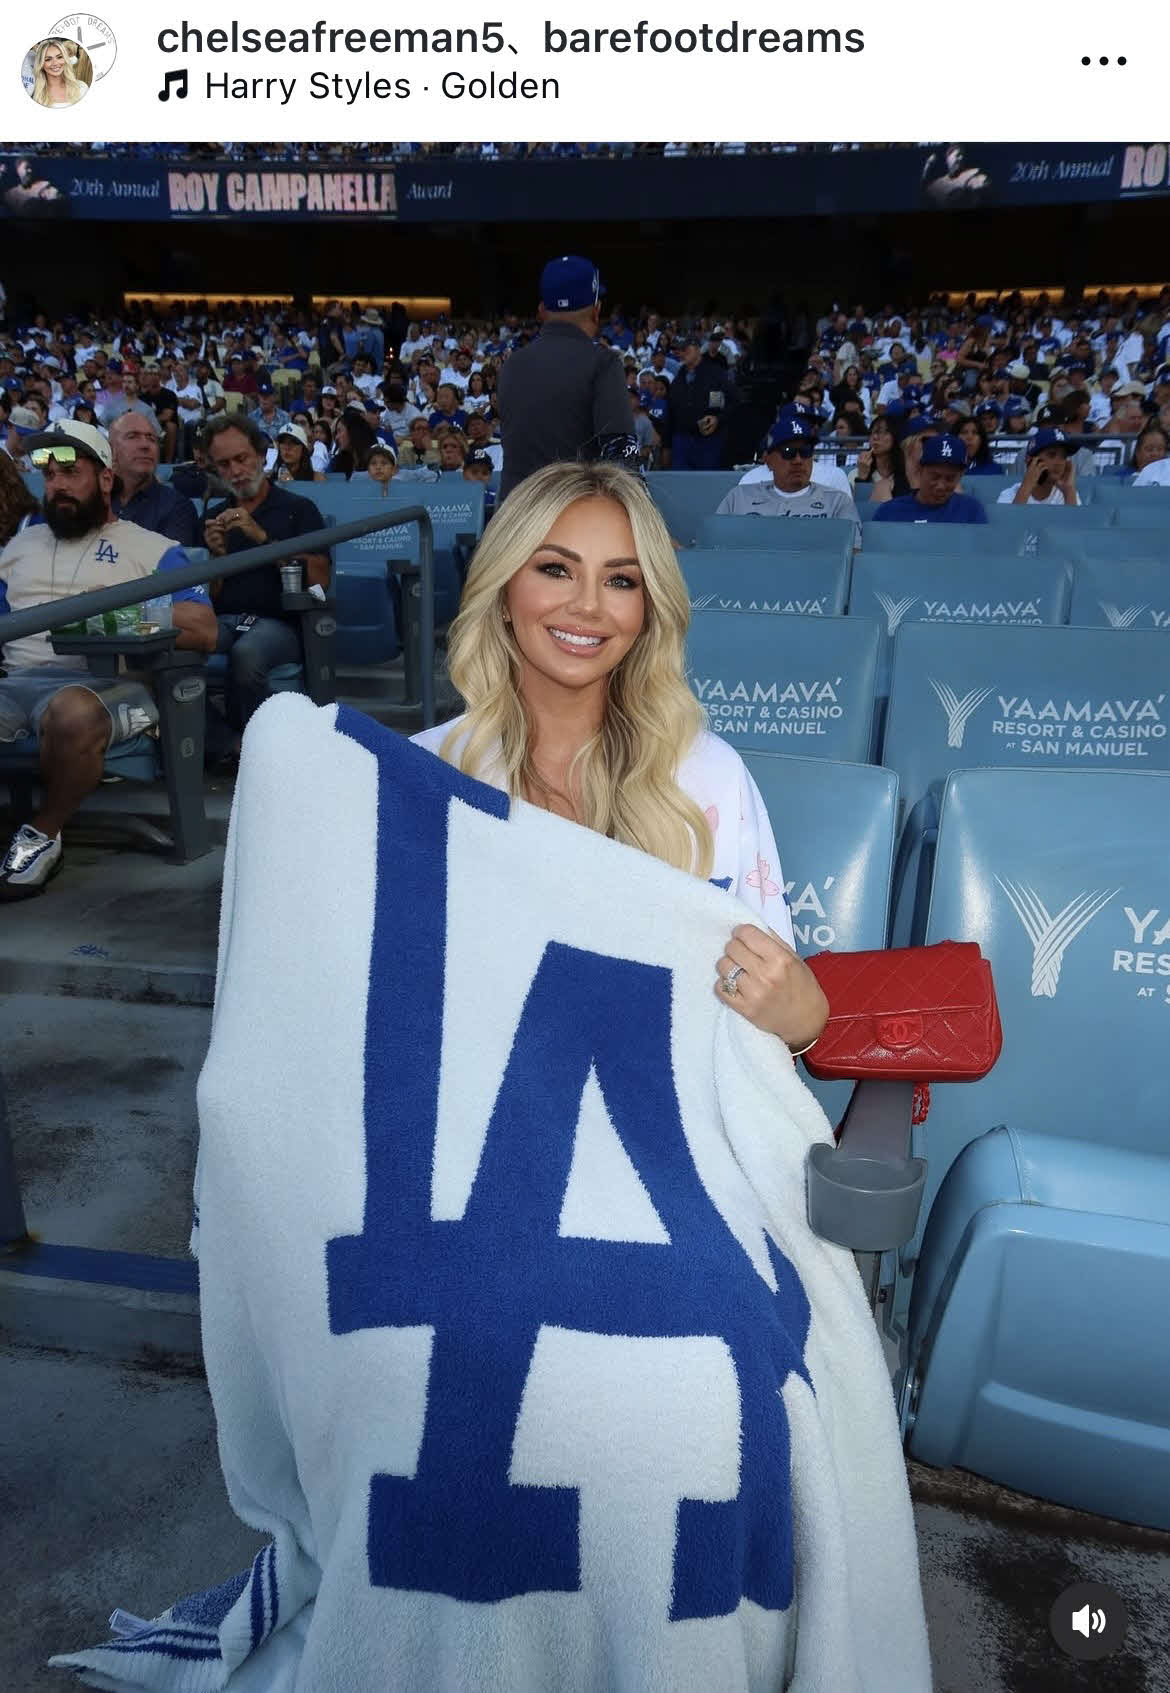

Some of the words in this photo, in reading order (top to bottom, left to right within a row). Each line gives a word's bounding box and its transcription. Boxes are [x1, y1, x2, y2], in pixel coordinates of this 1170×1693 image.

[1010, 160, 1049, 183] 20th
[1053, 154, 1116, 180] Annual
[1121, 143, 1170, 189] RO
[70, 178, 104, 197] 20th
[107, 179, 161, 198] Annual
[168, 171, 220, 212] ROY
[226, 172, 398, 212] CAMPANELLA
[407, 180, 454, 199] Award
[791, 420, 804, 435] LA
[941, 440, 953, 458] LA
[96, 538, 119, 564] LA
[924, 598, 1042, 617] YAAMAVA'
[694, 677, 843, 703] YAAMAVA'
[759, 706, 771, 719] &
[775, 706, 843, 719] CASINO
[998, 694, 1167, 722] YAAMAVA'
[713, 719, 749, 733] SAN
[753, 721, 827, 735] MANUEL
[992, 720, 1067, 738] RESORT
[1071, 724, 1085, 738] &
[1089, 724, 1168, 738] CASINO
[1020, 740, 1060, 755] SAN
[1065, 741, 1150, 757] MANUEL
[1136, 986, 1156, 997] AT
[325, 702, 815, 1622] LA
